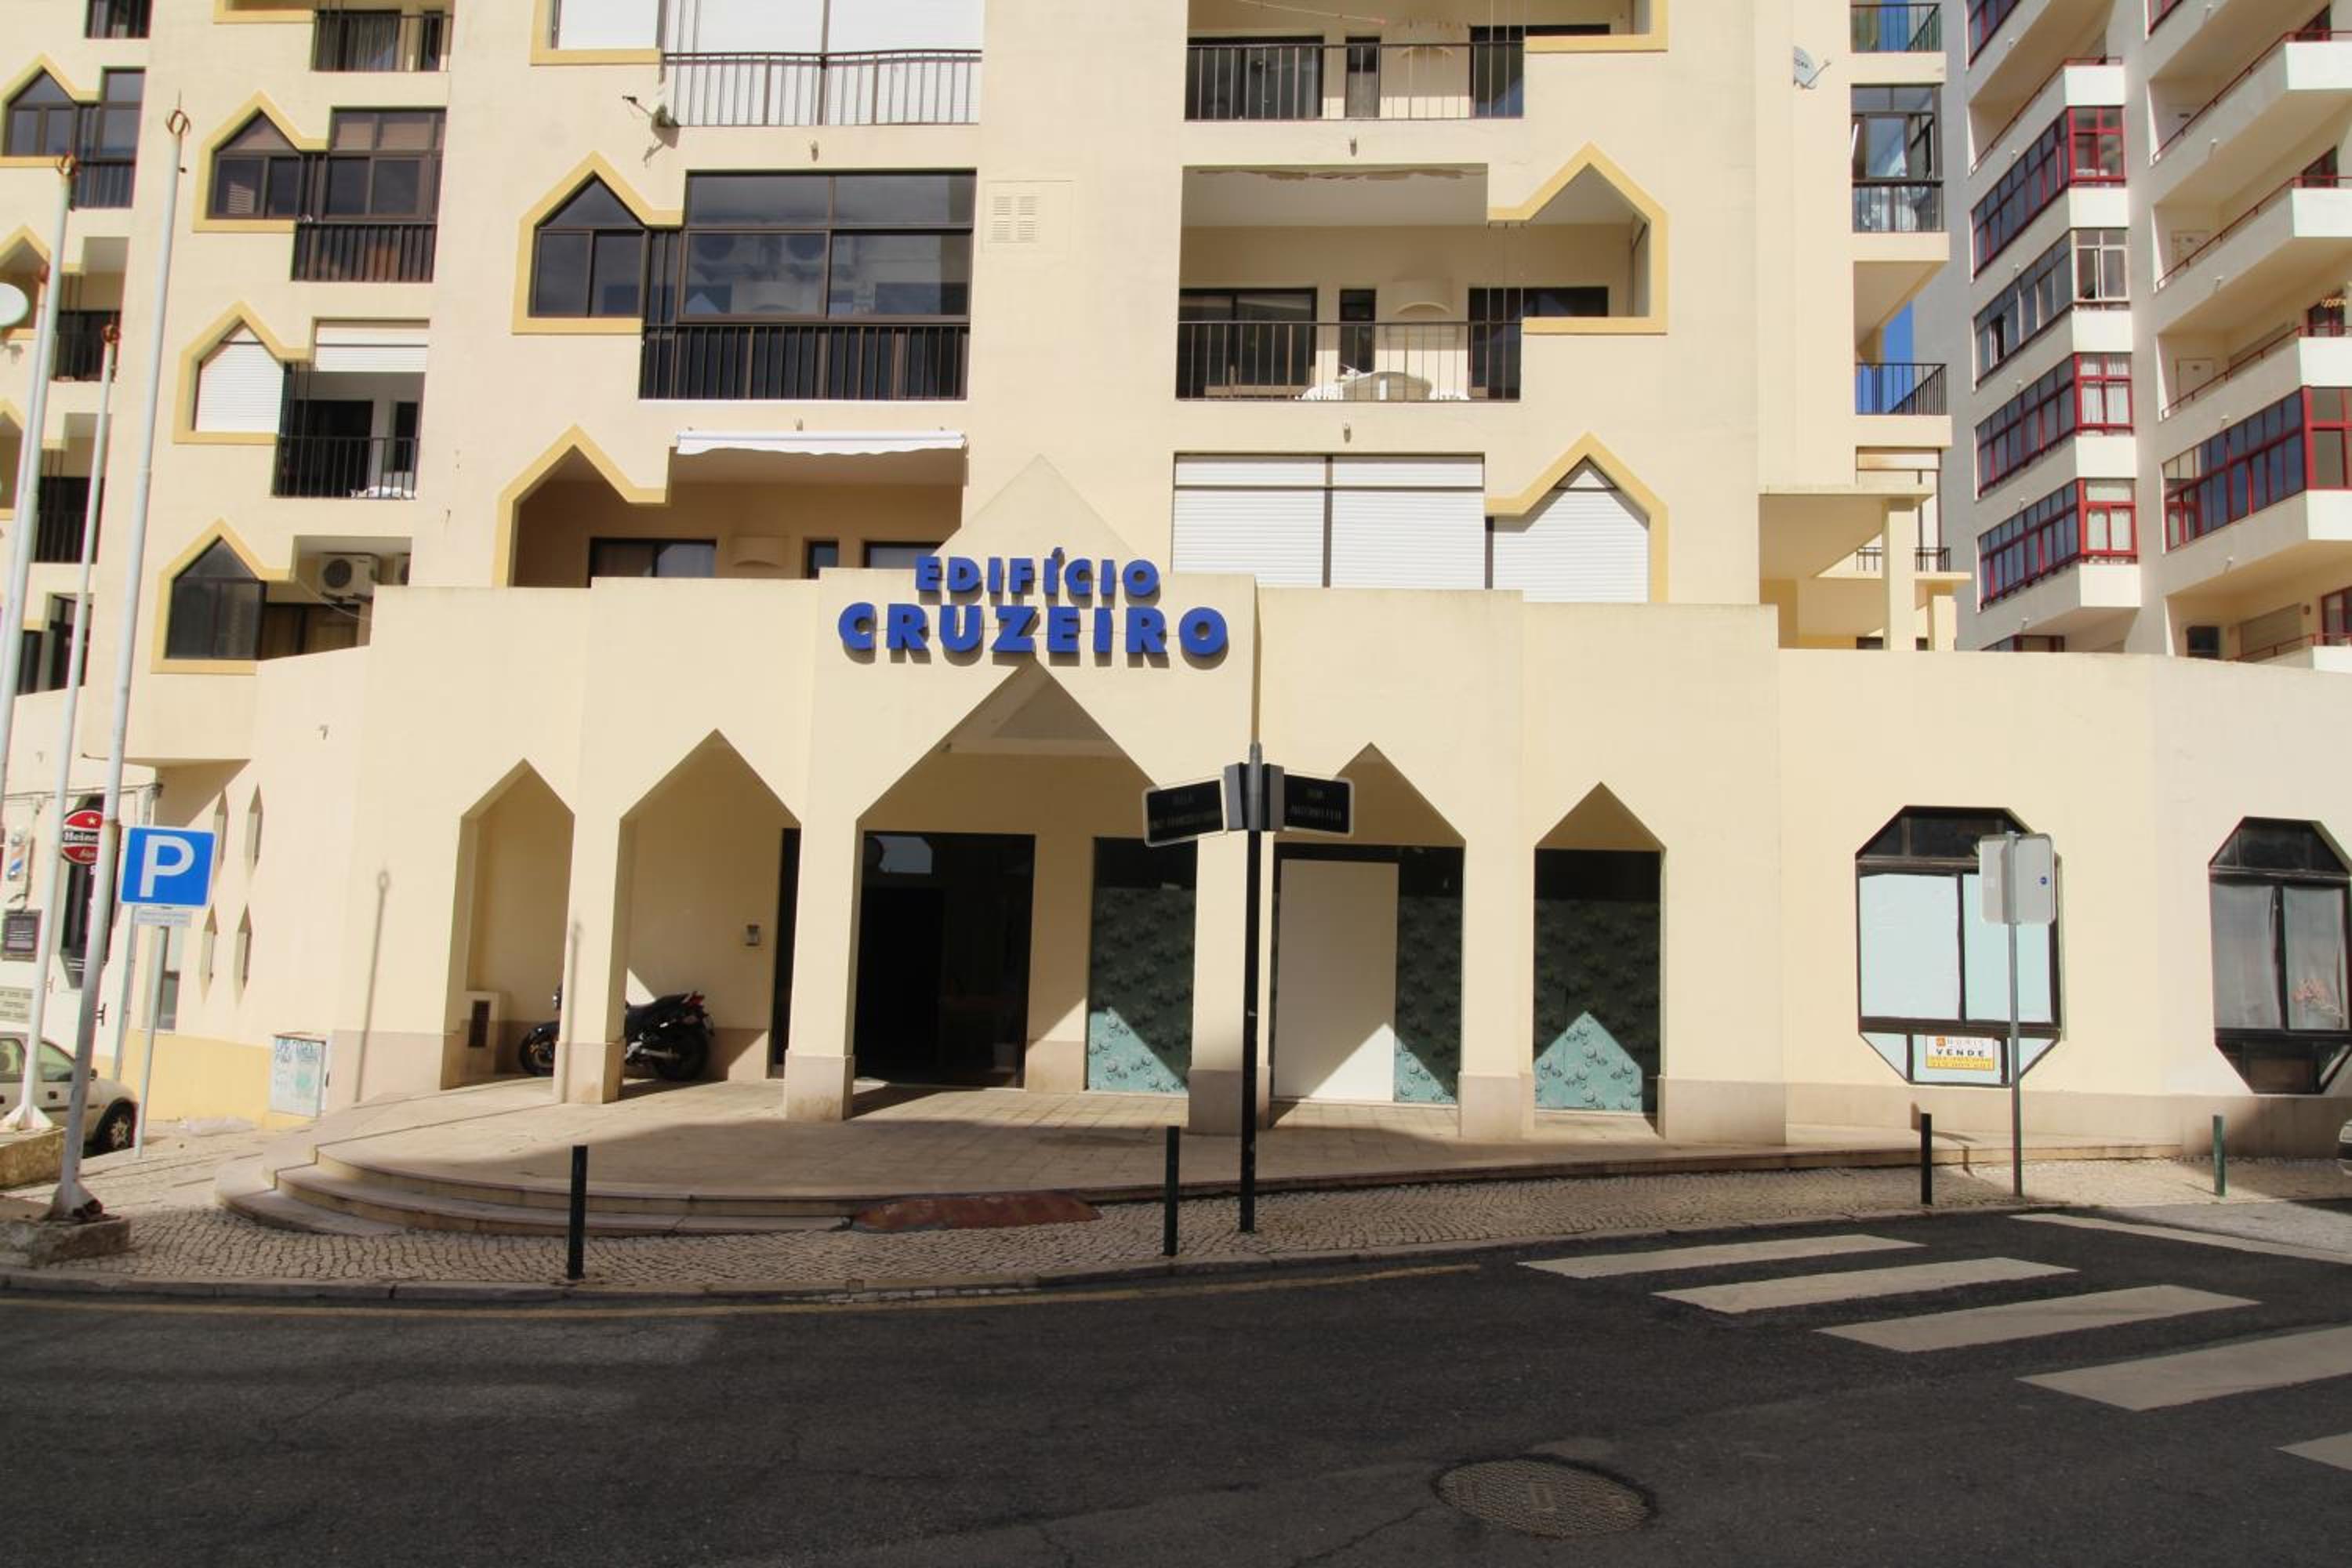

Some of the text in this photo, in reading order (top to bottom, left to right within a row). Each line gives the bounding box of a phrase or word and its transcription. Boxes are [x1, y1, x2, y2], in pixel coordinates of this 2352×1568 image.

[916, 546, 1160, 597] EDIFÍCIO
[838, 601, 1228, 657] CRUZEIRO
[140, 834, 195, 898] P
[1936, 1048, 1985, 1057] VENDE
